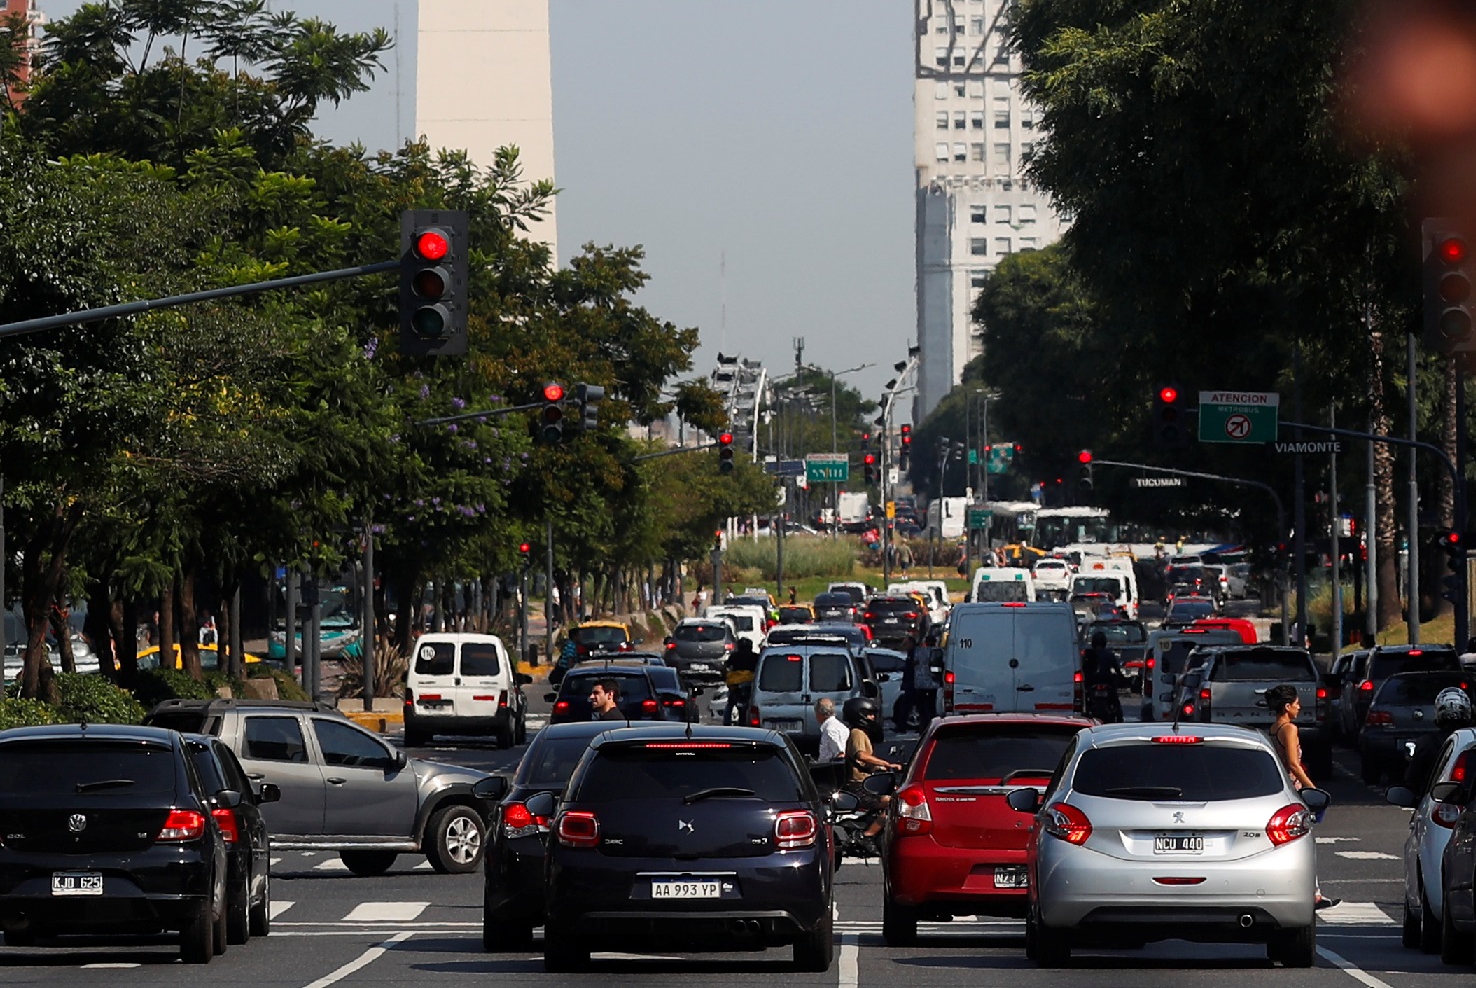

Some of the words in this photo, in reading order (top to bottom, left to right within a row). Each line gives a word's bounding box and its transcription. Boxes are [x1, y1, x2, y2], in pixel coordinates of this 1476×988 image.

[1211, 393, 1268, 403] ATENCION
[1275, 441, 1341, 453] VIAMONTE
[961, 639, 972, 649] 110
[423, 647, 434, 659] 110
[1156, 838, 1177, 850] NCU
[1182, 838, 1203, 850] 440
[80, 877, 101, 888] 625
[655, 885, 670, 896] AA
[674, 884, 698, 896] 993
[702, 884, 717, 896] YP
